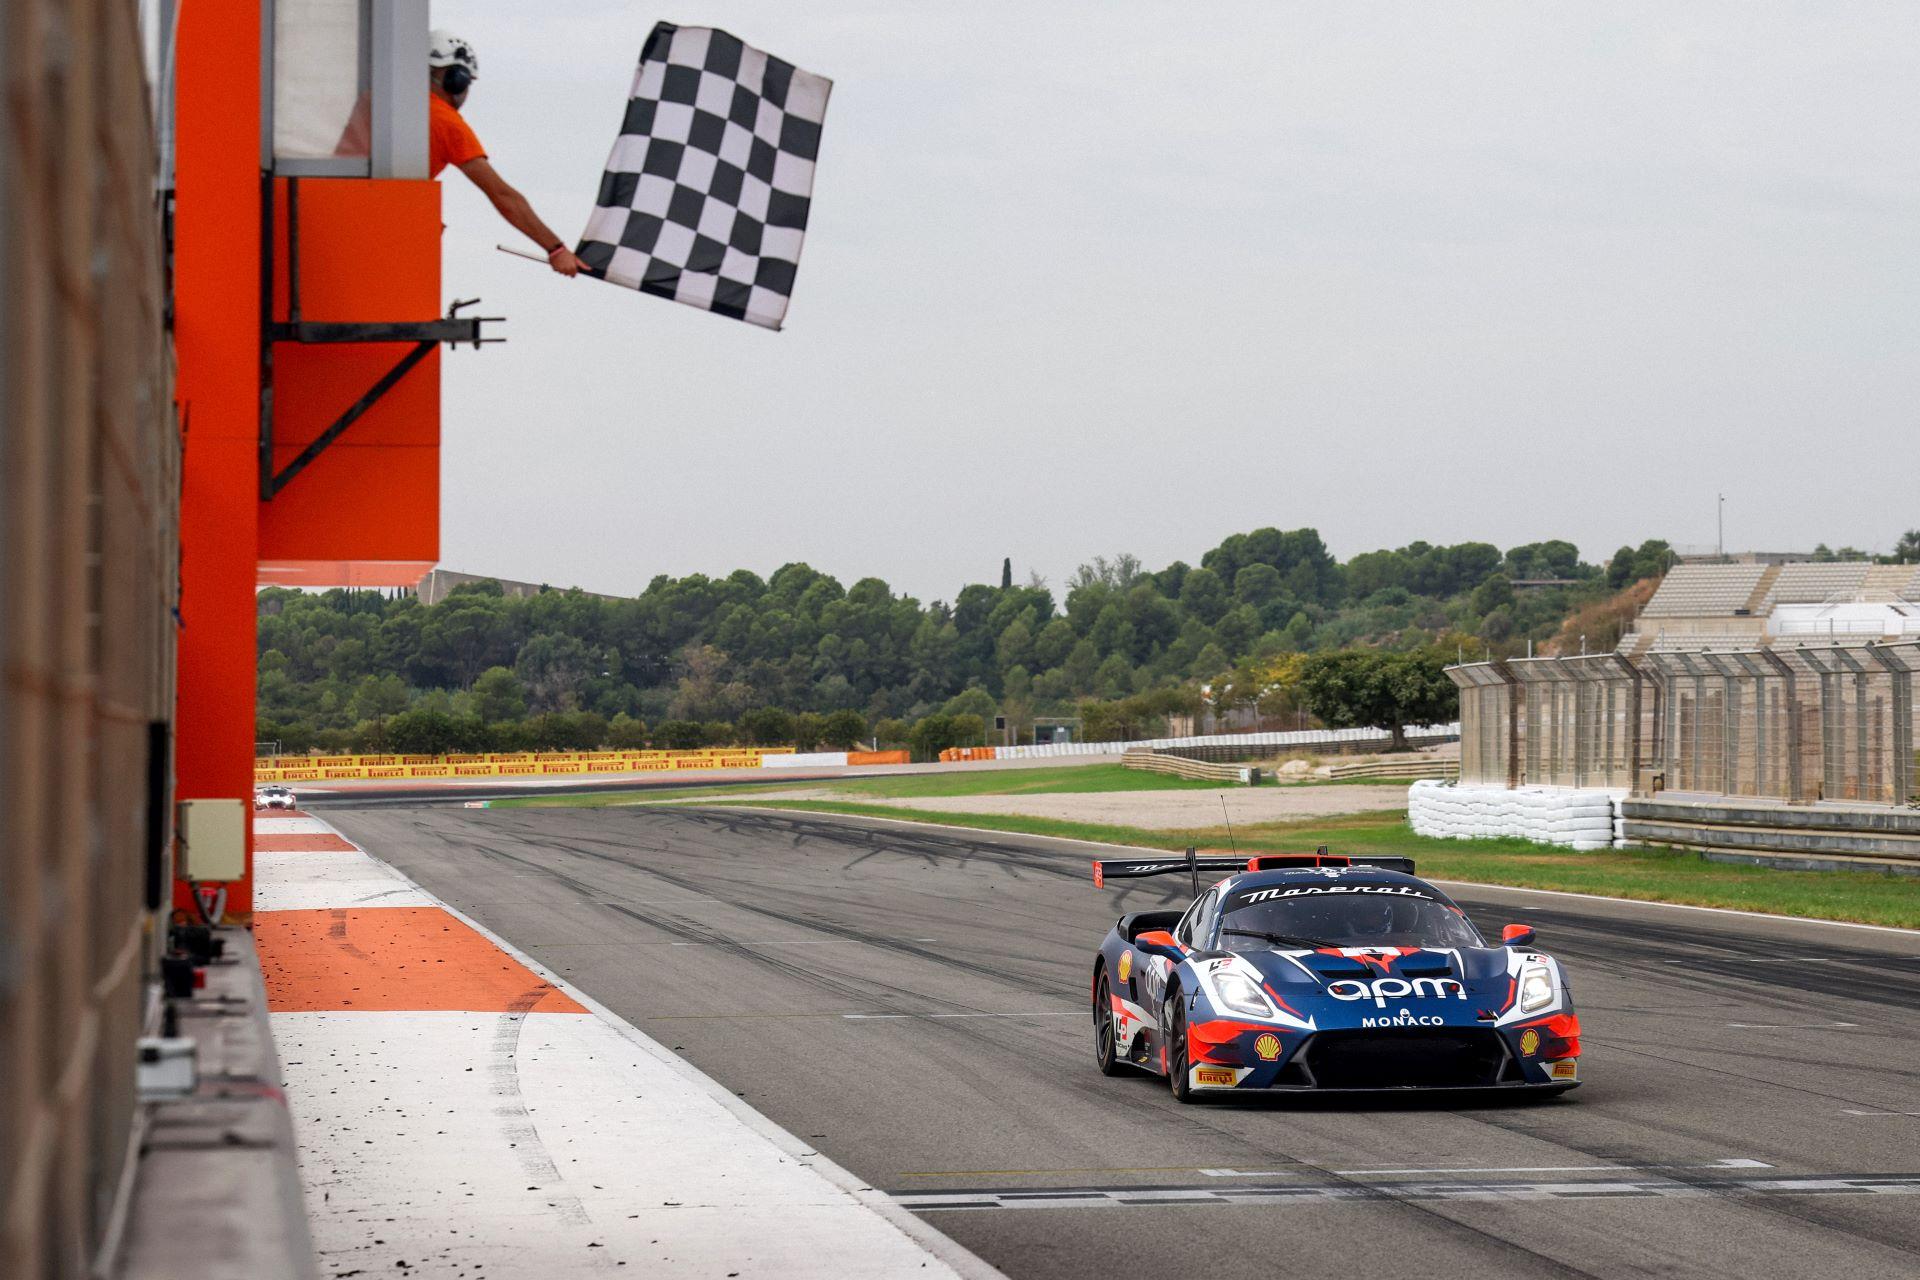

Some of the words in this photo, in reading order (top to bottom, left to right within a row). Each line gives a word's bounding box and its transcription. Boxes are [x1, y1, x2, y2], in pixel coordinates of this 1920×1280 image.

[283, 769, 318, 780] PIRELLI
[325, 768, 361, 779] PIRELLI
[368, 767, 404, 778] PIRELLI
[411, 766, 448, 777] PIRELLI
[455, 765, 491, 776] PIRELLI
[499, 764, 536, 774] PIRELLI
[543, 763, 580, 773] PIRELLI
[587, 761, 625, 772] PIRELLI
[632, 760, 669, 770] PIRELLI
[677, 758, 714, 769] PIRELLI
[721, 757, 759, 768] PIRELLI
[1240, 886, 1434, 903] Maserati
[1327, 977, 1468, 1009] apm
[1362, 1015, 1444, 1028] MONACO
[1198, 1071, 1233, 1083] PIRELLI
